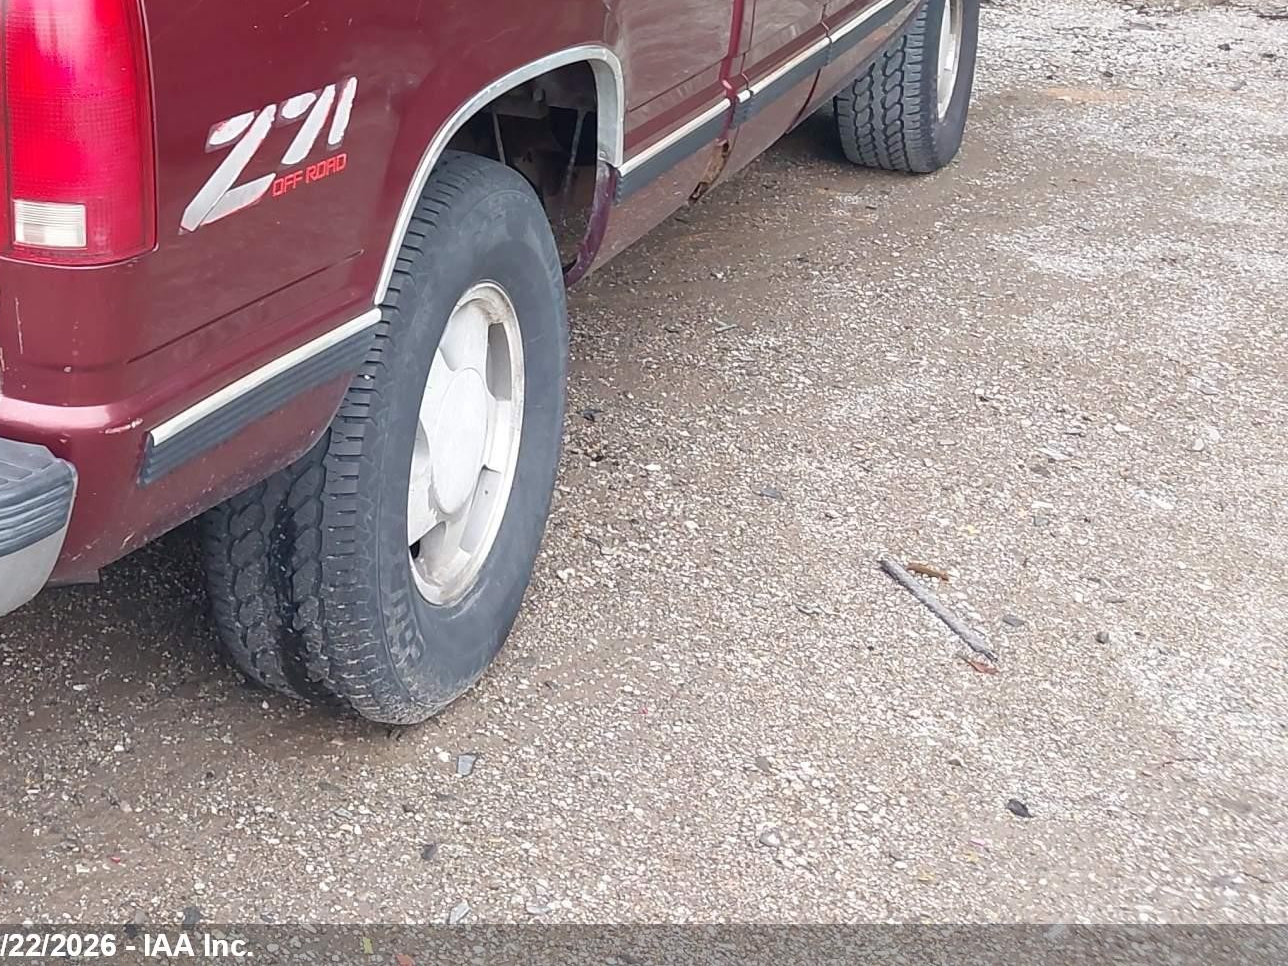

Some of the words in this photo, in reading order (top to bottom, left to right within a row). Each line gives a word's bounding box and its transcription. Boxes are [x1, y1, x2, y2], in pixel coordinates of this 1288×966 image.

[180, 76, 360, 233] Z71
[271, 170, 304, 197] OFF
[305, 152, 348, 184] ROAD
